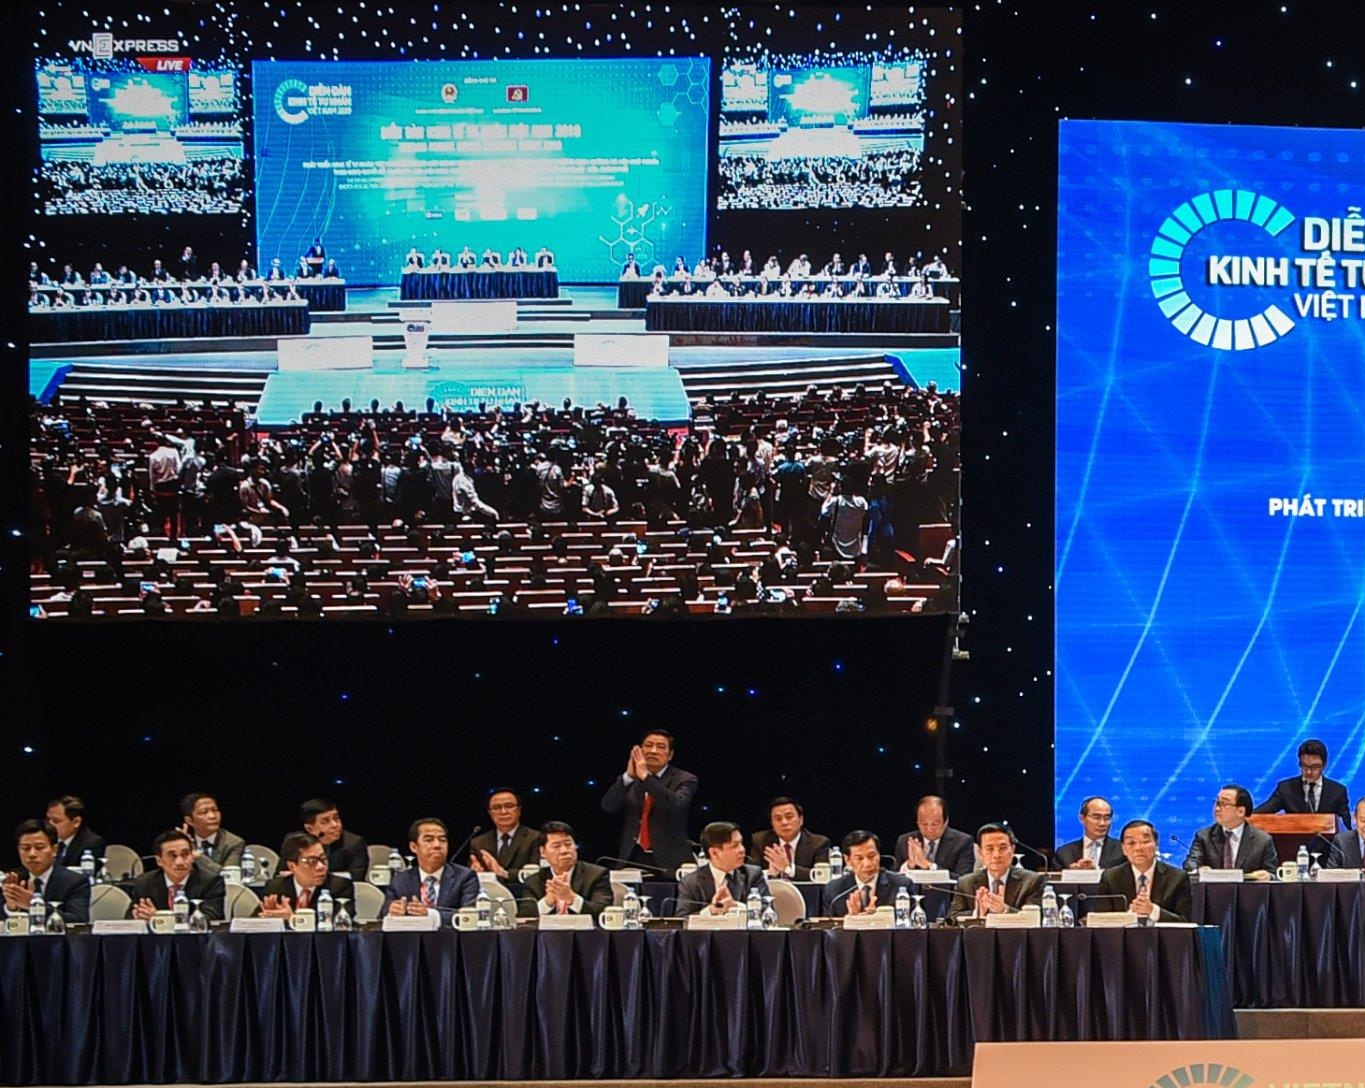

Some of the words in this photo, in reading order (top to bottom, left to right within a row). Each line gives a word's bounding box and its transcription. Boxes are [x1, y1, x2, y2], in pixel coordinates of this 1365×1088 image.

[157, 60, 183, 71] LIVE
[1210, 256, 1289, 286] KINH
[1295, 250, 1336, 288] TẾ
[1294, 290, 1354, 321] VIỆT
[1269, 494, 1326, 516] PHÁT
